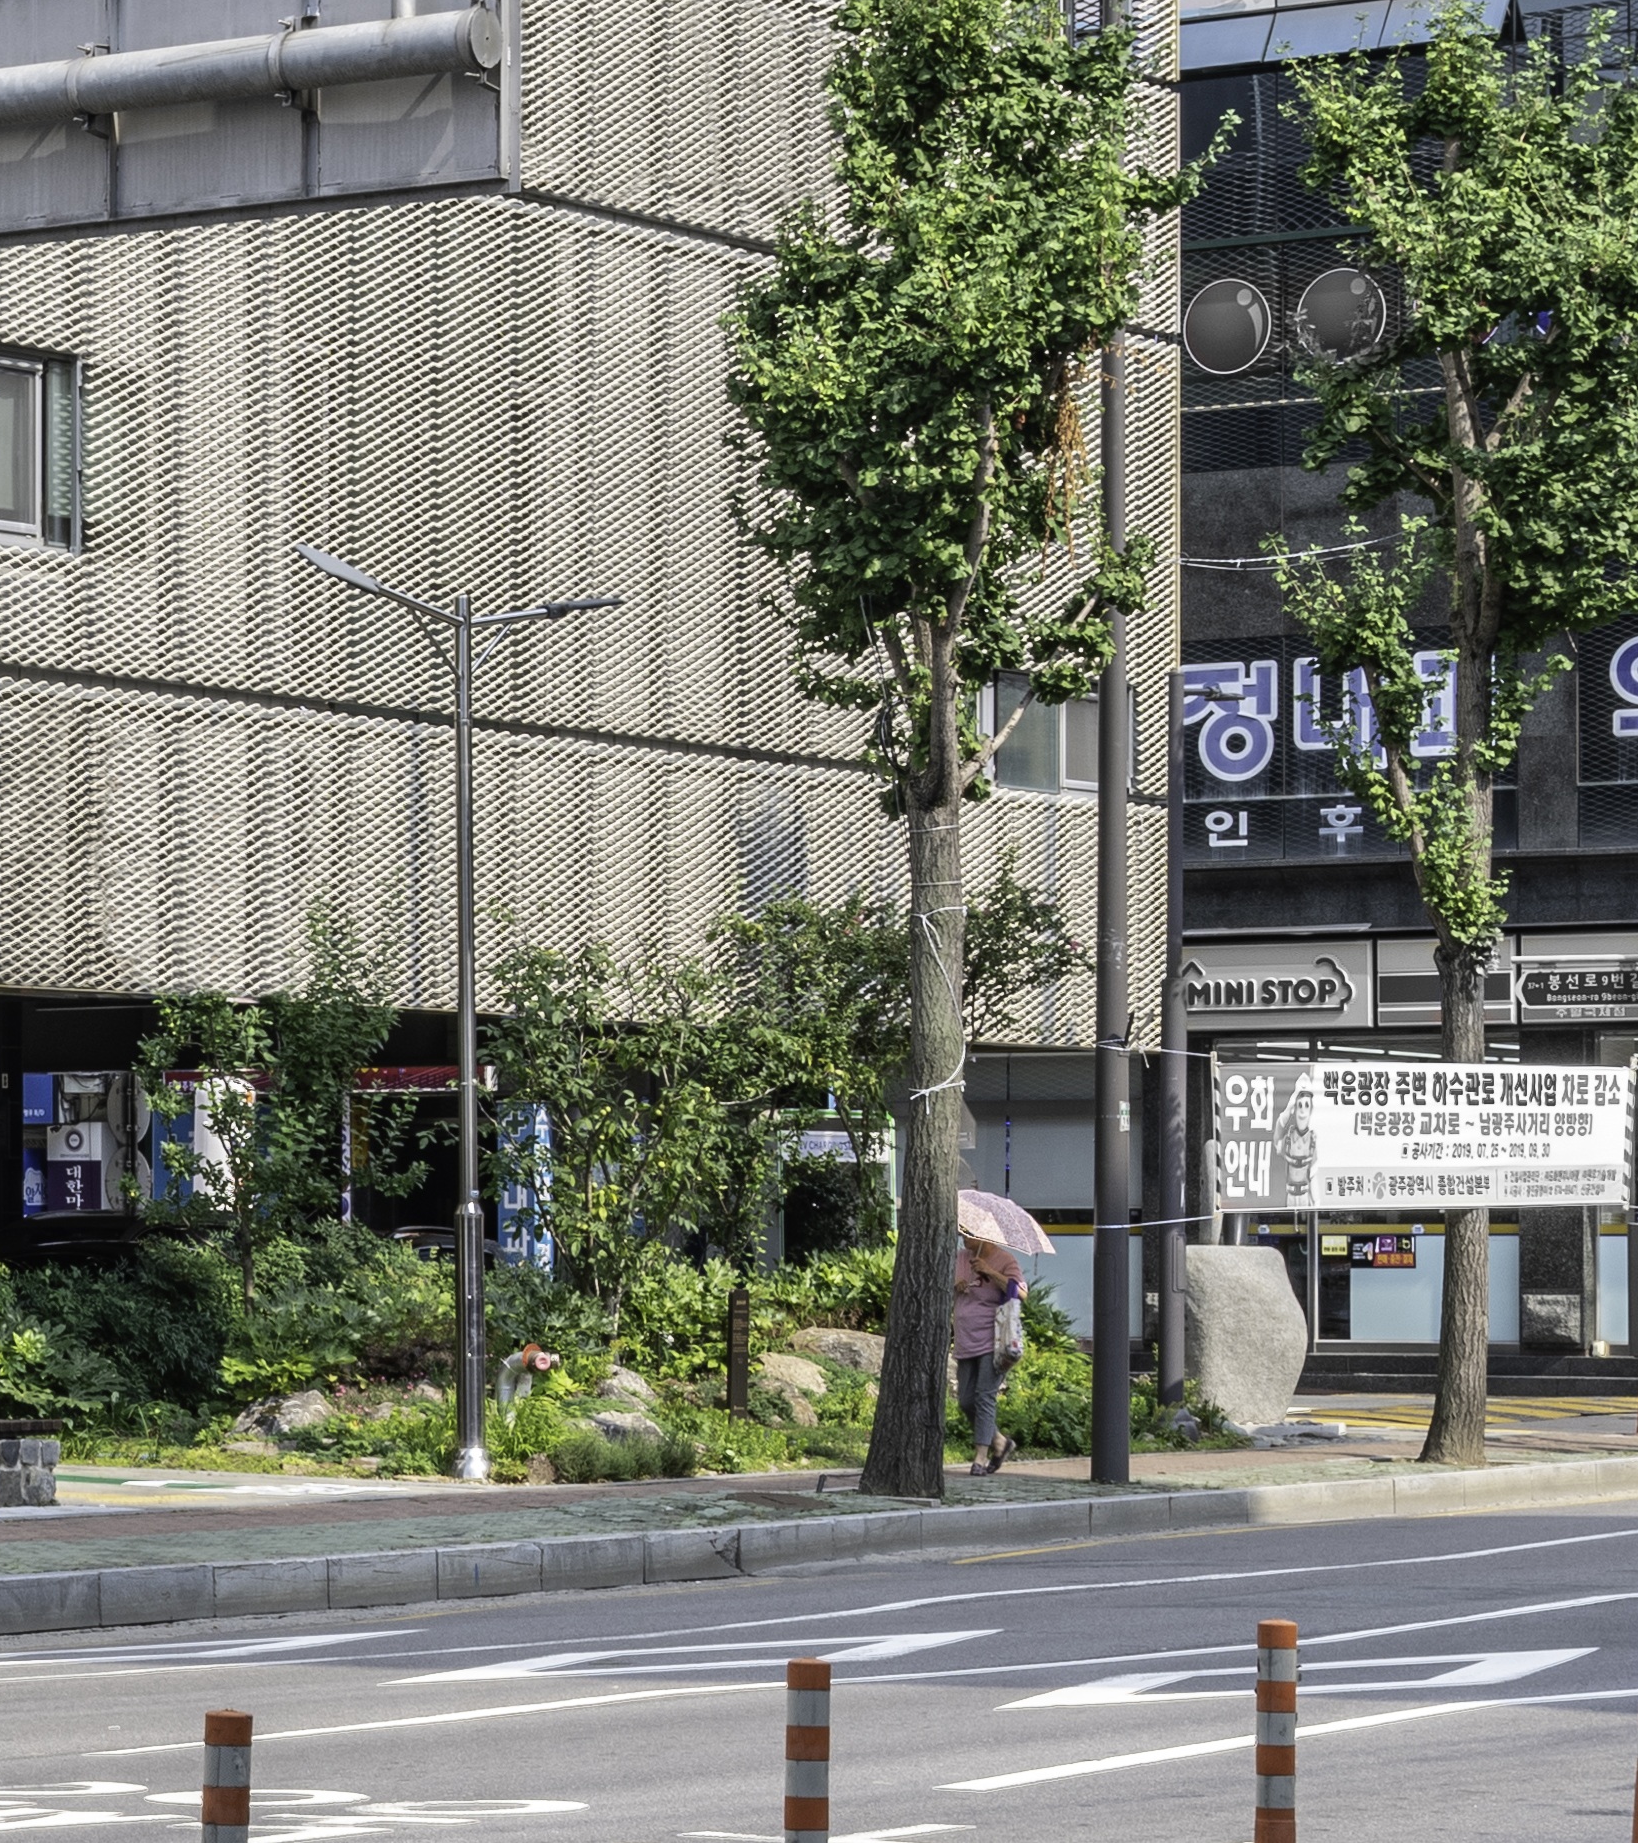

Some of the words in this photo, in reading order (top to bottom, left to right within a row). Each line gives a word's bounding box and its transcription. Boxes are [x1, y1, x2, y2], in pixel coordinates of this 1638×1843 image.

[1225, 1074, 1274, 1132] 우회
[1323, 1070, 1390, 1106] 백운광장
[1395, 1071, 1427, 1106] 주변
[1432, 1071, 1495, 1106] 하수관로
[1500, 1072, 1557, 1107] 개선사업
[1561, 1074, 1589, 1106] 차로
[1594, 1074, 1621, 1106] 감소
[1419, 1112, 1460, 1136] 교차로
[1479, 1112, 1550, 1136] 남광주사거리
[1411, 1142, 1444, 1160] 공사기간
[1225, 1140, 1272, 1198] 안내
[1337, 1175, 1364, 1197] 발주처
[1388, 1174, 1434, 1197] 광주광역시
[1437, 1174, 1491, 1196] 종합건설본부
